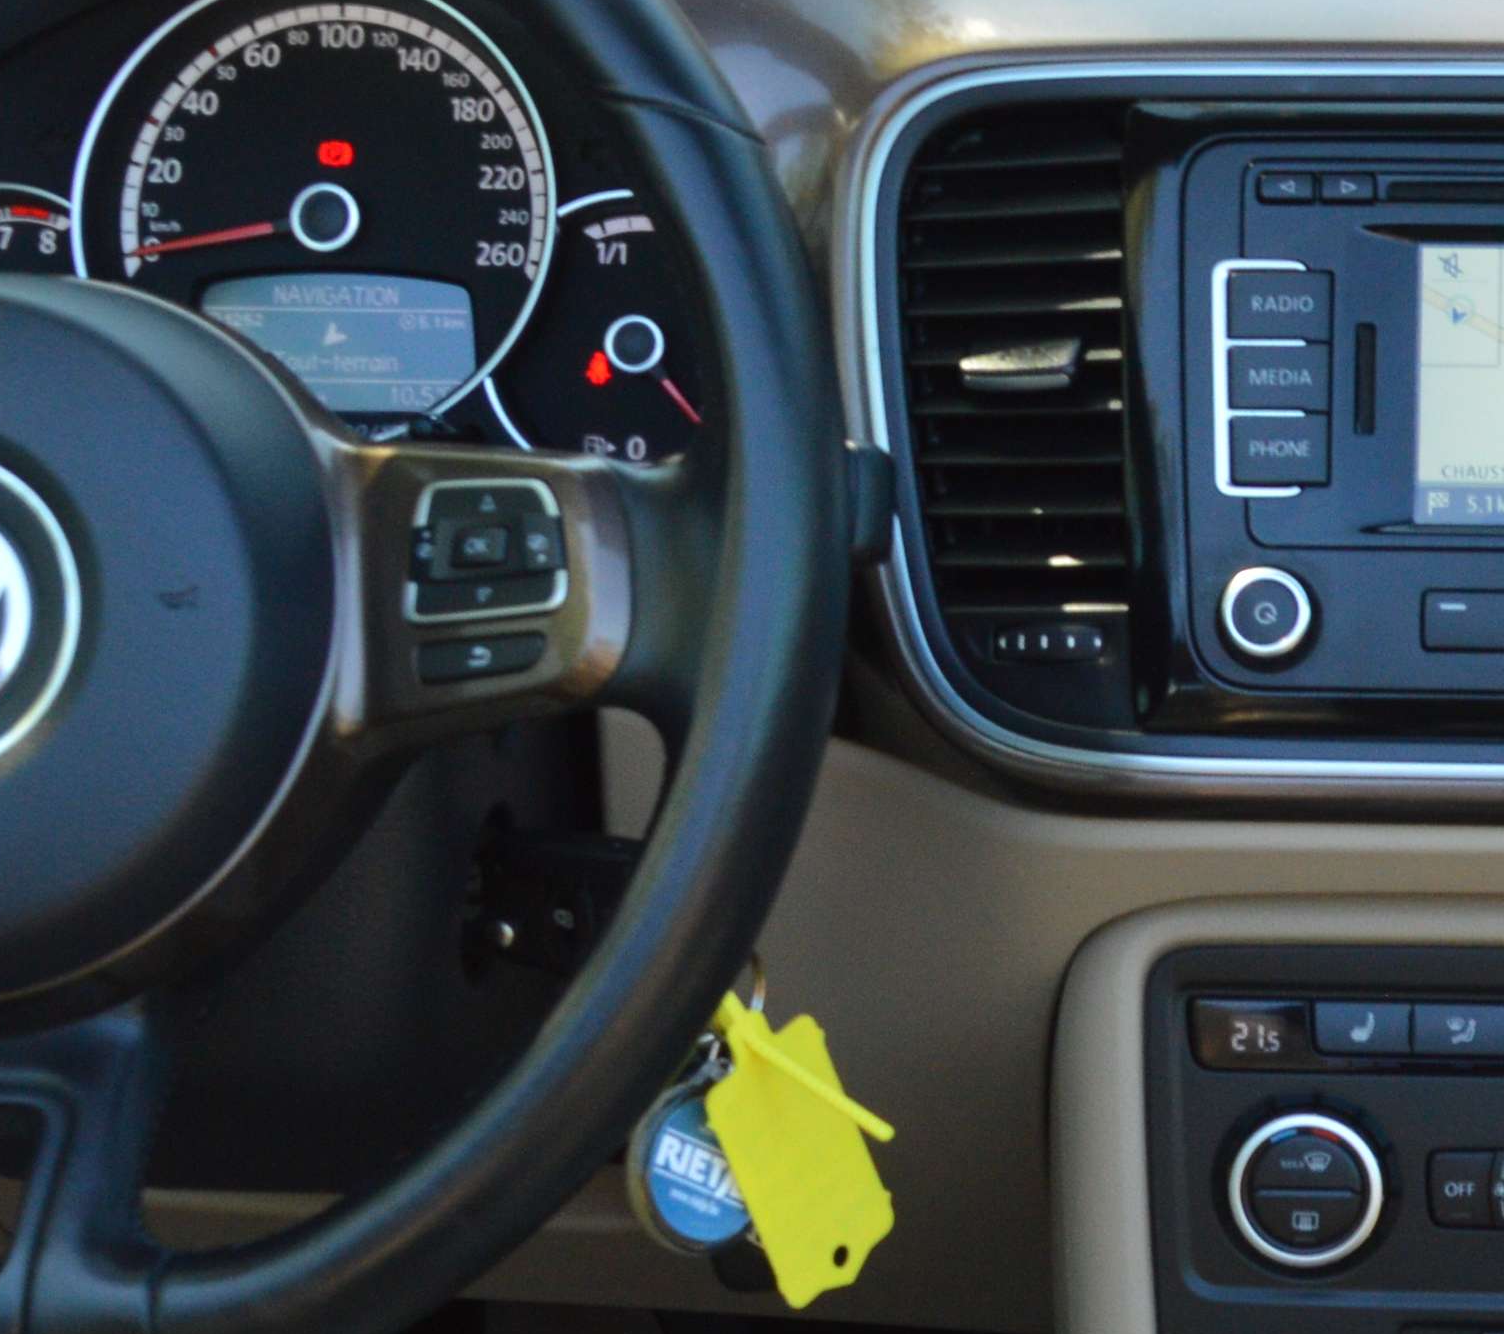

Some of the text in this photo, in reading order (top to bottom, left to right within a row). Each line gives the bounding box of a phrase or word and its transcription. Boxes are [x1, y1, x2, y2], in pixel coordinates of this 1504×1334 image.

[288, 30, 310, 46] 80
[318, 23, 364, 49] 100
[372, 32, 398, 47] 120
[243, 41, 281, 68] 60
[397, 47, 441, 72] 140
[216, 65, 237, 81] 50
[442, 72, 470, 88] 160
[181, 88, 219, 116] 40
[451, 97, 495, 122] 180
[164, 126, 186, 142] 30
[480, 133, 513, 149] 200
[147, 156, 183, 184] 20
[477, 166, 525, 190] 220
[142, 202, 160, 218] 10
[498, 209, 529, 225] 240
[38, 229, 57, 255] 8
[475, 241, 525, 267] 260
[596, 242, 628, 265] 1/1
[272, 285, 400, 306] NAVIGATION
[1251, 294, 1314, 312] RADIO
[1248, 368, 1312, 386] MEDIA
[626, 436, 647, 461] 0
[1248, 440, 1311, 457] PHONE
[1445, 1183, 1475, 1197] OFF
